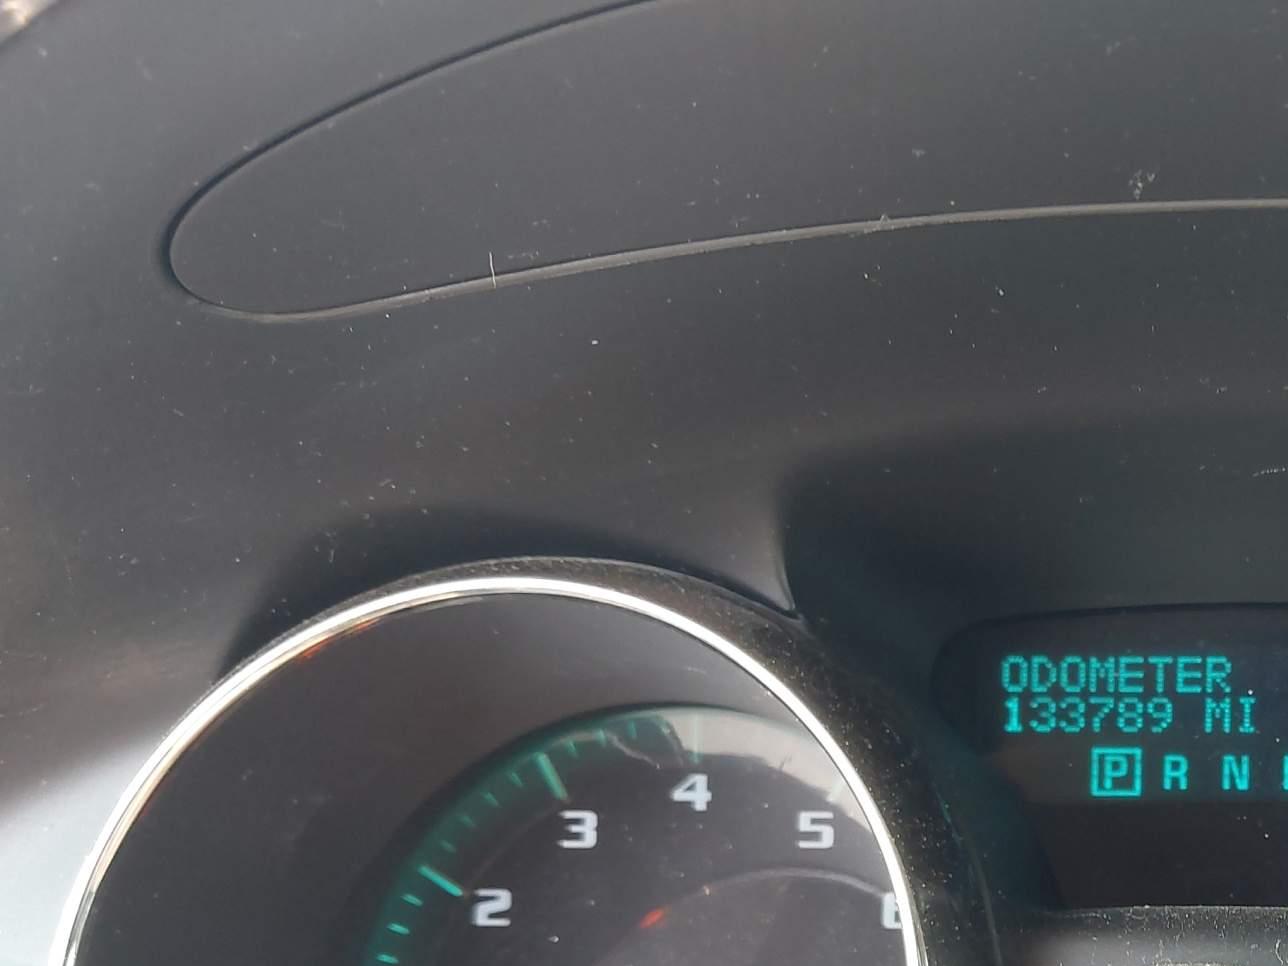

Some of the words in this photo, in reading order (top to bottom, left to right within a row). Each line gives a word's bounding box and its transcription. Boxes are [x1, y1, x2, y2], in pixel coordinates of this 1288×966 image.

[1001, 656, 1233, 693] ODOMETER
[1003, 697, 1174, 733] 133789
[1204, 697, 1258, 733] MI
[672, 772, 713, 811] 4
[1101, 757, 1128, 791] P
[1162, 755, 1189, 790] R
[1221, 755, 1250, 790] N
[556, 809, 599, 850] 3
[796, 810, 835, 850] 5
[471, 888, 513, 928] 2
